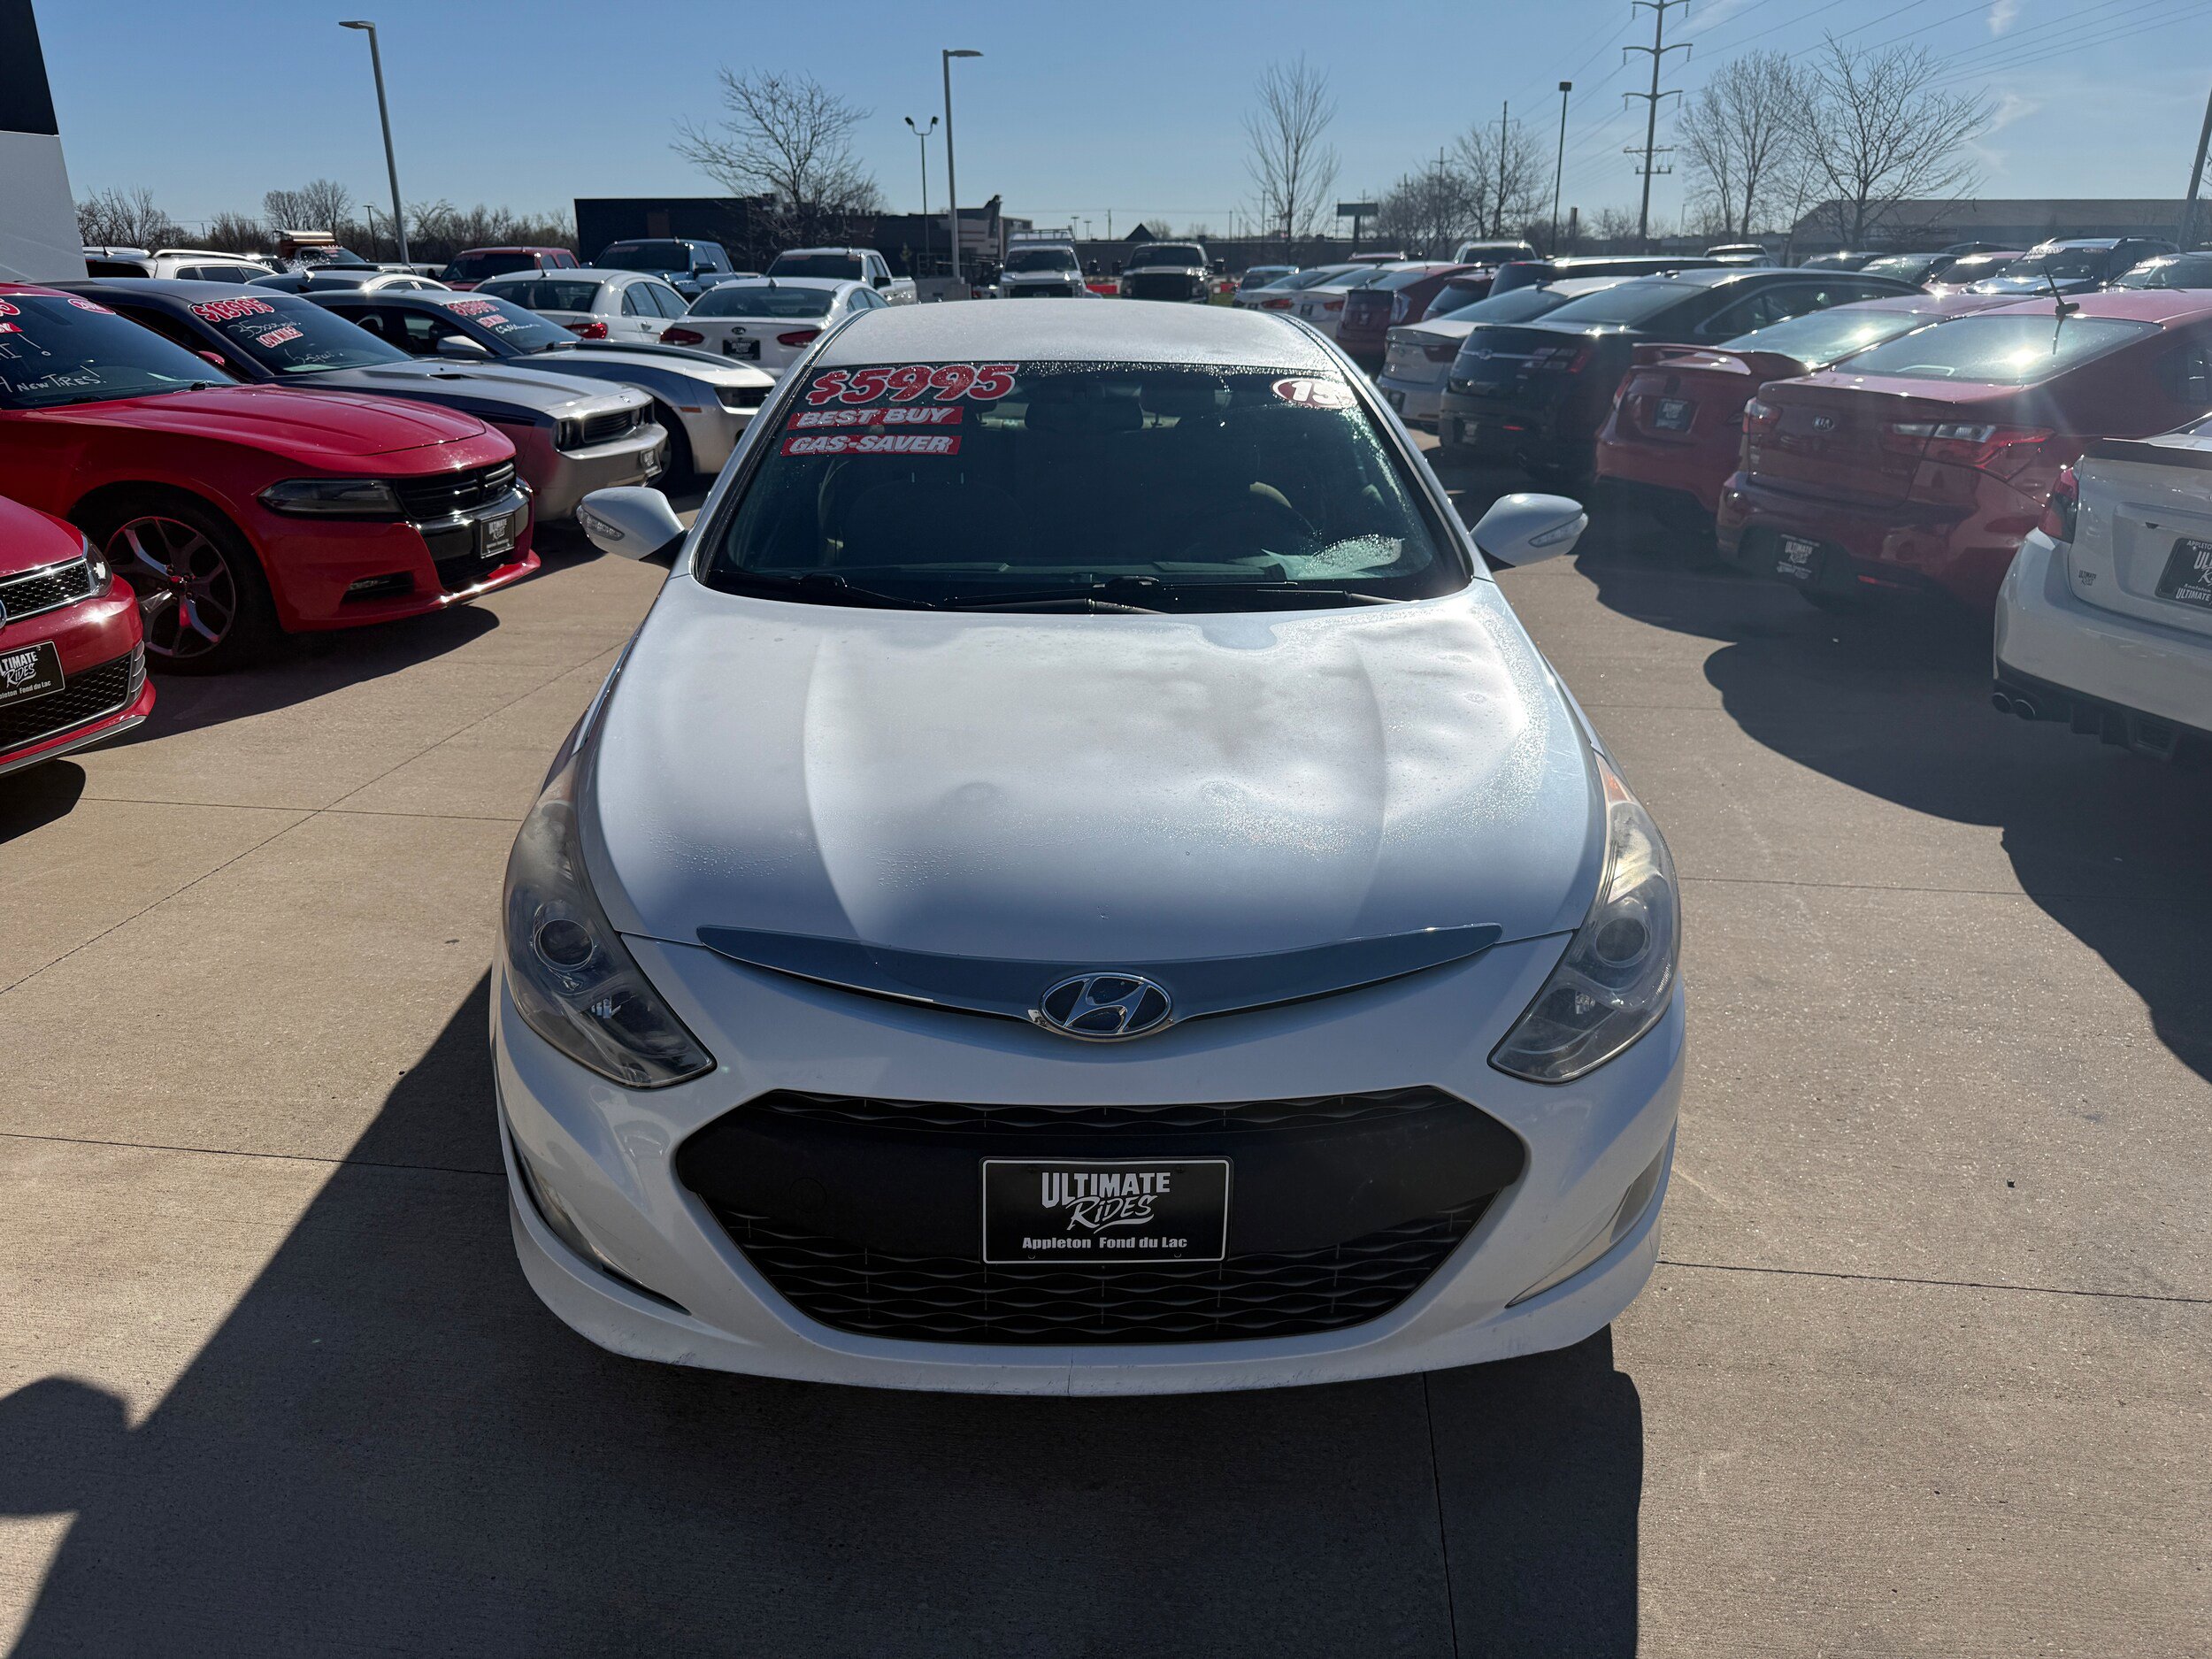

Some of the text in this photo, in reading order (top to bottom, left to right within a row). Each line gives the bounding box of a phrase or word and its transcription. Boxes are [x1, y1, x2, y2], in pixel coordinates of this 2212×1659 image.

[806, 364, 1019, 406] $5995
[797, 407, 955, 428] BEST BUY
[789, 435, 955, 453] GAS-SAVER
[2176, 588, 2211, 602] ULTIMATE
[1041, 1172, 1171, 1209] ULTIMATE
[1022, 1237, 1187, 1250] Appleton Fond du Lac
